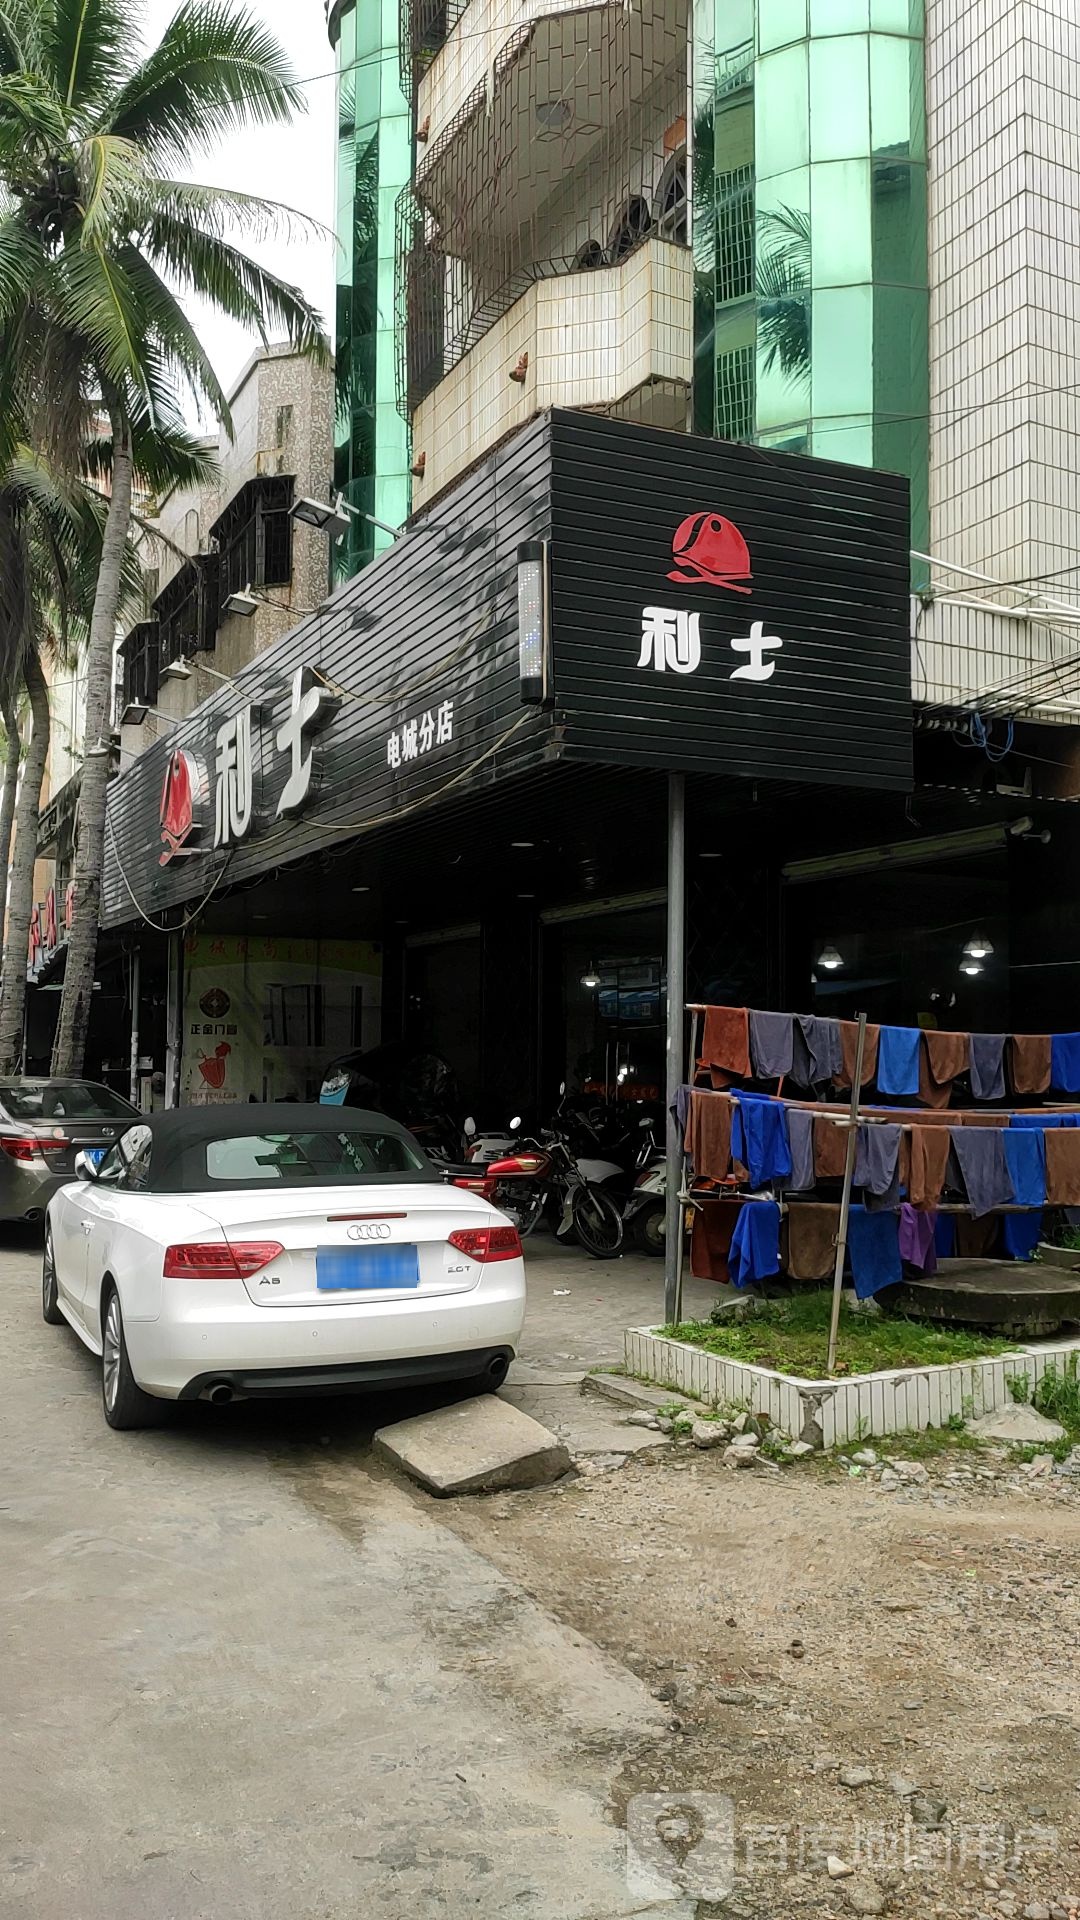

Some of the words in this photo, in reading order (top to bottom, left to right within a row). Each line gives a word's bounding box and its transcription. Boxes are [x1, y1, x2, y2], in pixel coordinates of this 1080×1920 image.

[637, 606, 783, 681] 利士
[214, 665, 334, 849] 利士
[386, 699, 455, 769] 电城分店
